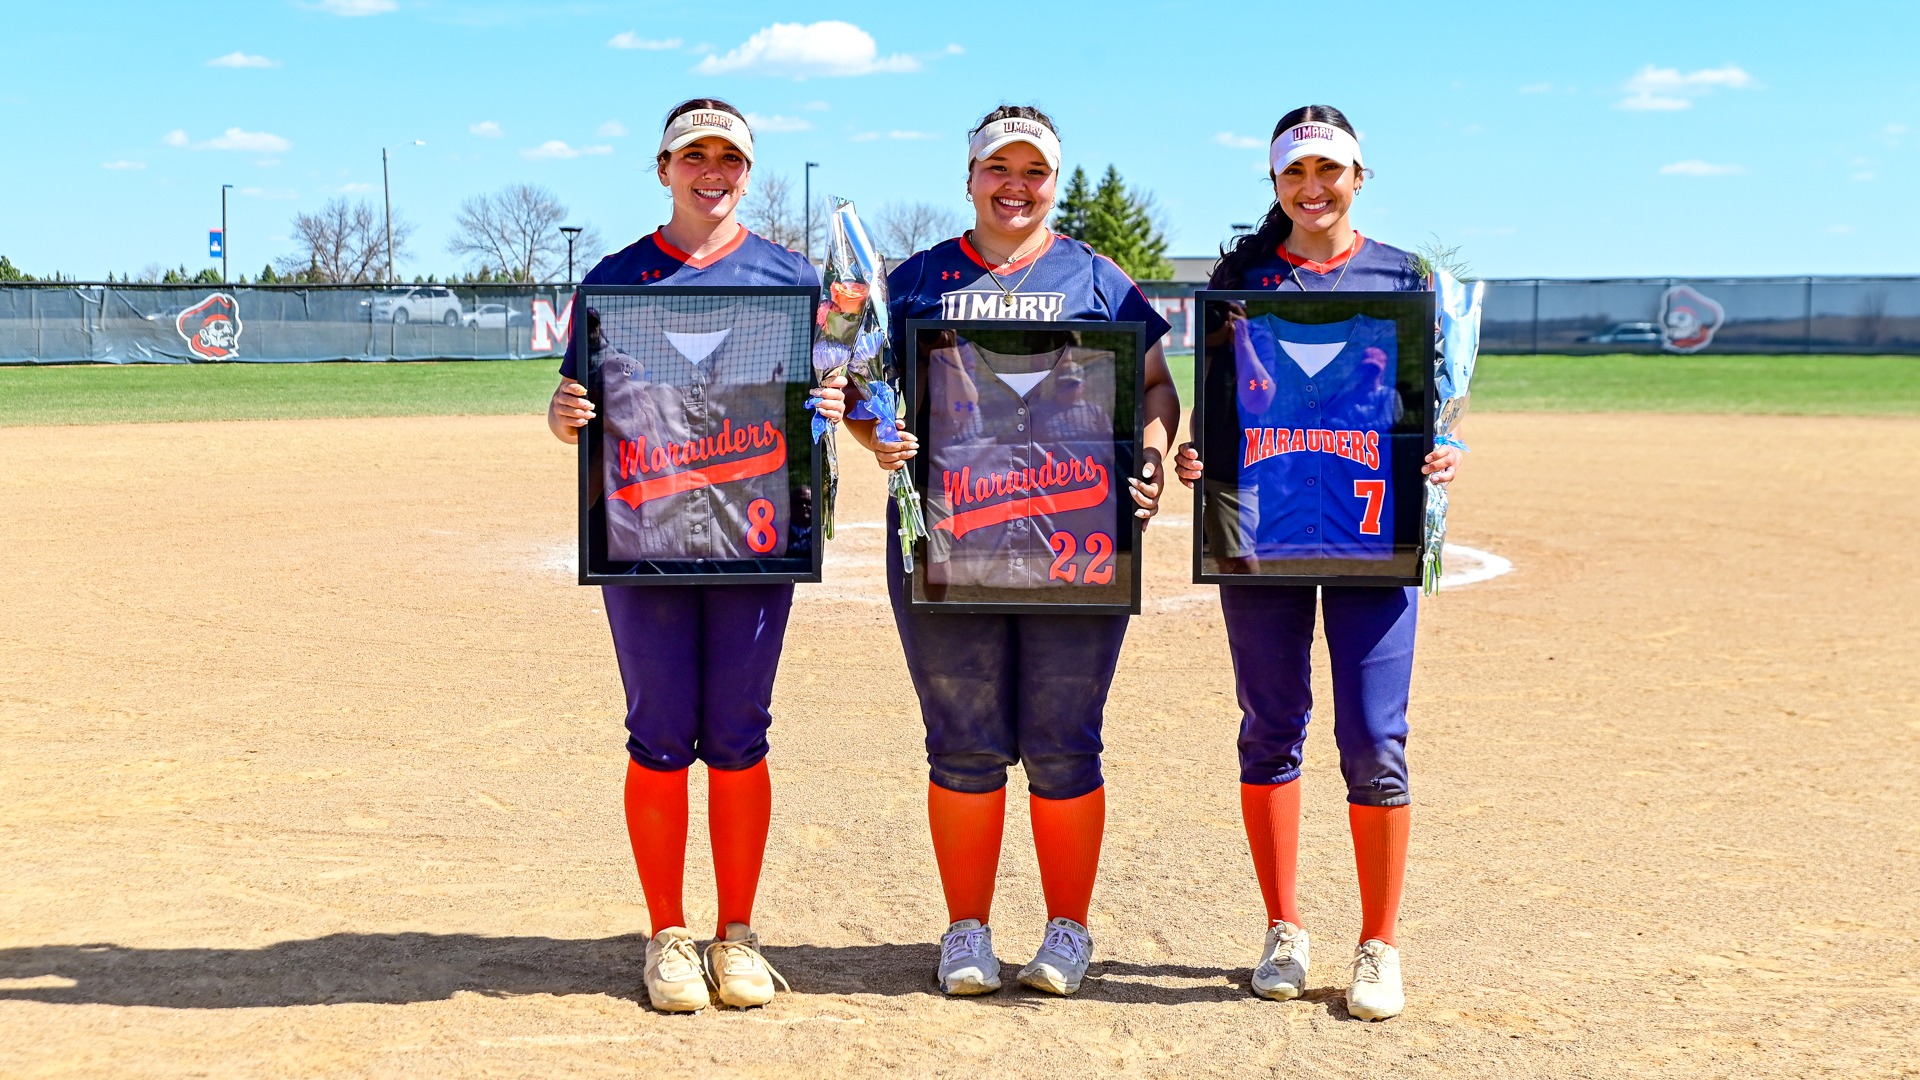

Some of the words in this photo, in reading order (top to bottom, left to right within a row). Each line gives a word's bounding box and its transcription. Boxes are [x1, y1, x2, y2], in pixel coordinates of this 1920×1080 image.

[692, 113, 733, 131] UMARY
[1004, 121, 1043, 138] UMARY
[1293, 125, 1333, 141] UMARY
[944, 292, 1062, 321] UMARY
[619, 418, 776, 480] Marauders
[1244, 428, 1380, 471] MARAUDERS
[943, 451, 1099, 510] Marauders
[746, 498, 778, 553] 8
[1354, 479, 1386, 535] 7
[1049, 529, 1114, 585] 22
